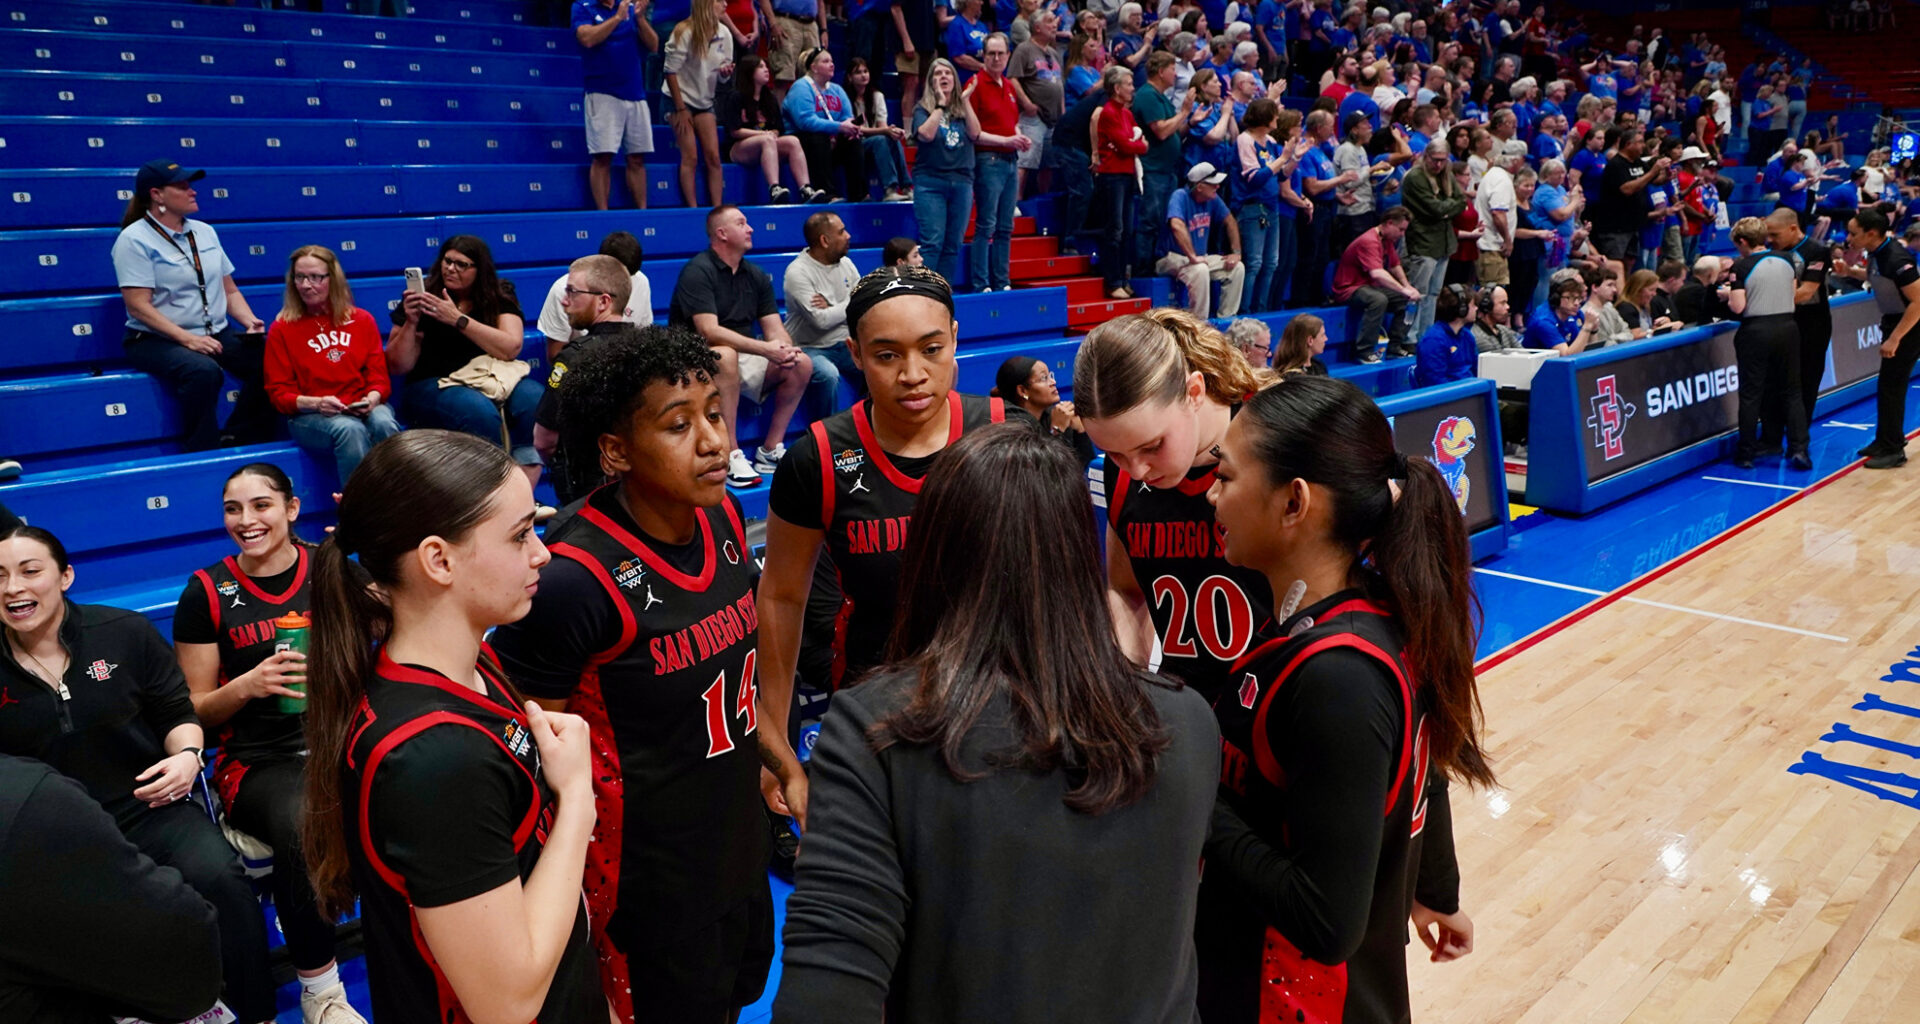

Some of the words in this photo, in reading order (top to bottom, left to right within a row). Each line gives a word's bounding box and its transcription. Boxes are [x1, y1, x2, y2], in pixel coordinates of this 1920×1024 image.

[307, 330, 351, 353] SDSU
[1646, 380, 1693, 418] SAN
[1696, 365, 1739, 400] DIEG
[834, 454, 864, 467] WBIT
[846, 519, 881, 554] SAN
[1127, 522, 1152, 558] SAN
[1154, 520, 1210, 558] DIEGO
[616, 564, 643, 583] WBIT
[228, 622, 259, 649] SAN
[1152, 574, 1254, 661] 20
[650, 628, 696, 675] SAN
[690, 604, 744, 661] DIEGO
[701, 648, 757, 759] 14
